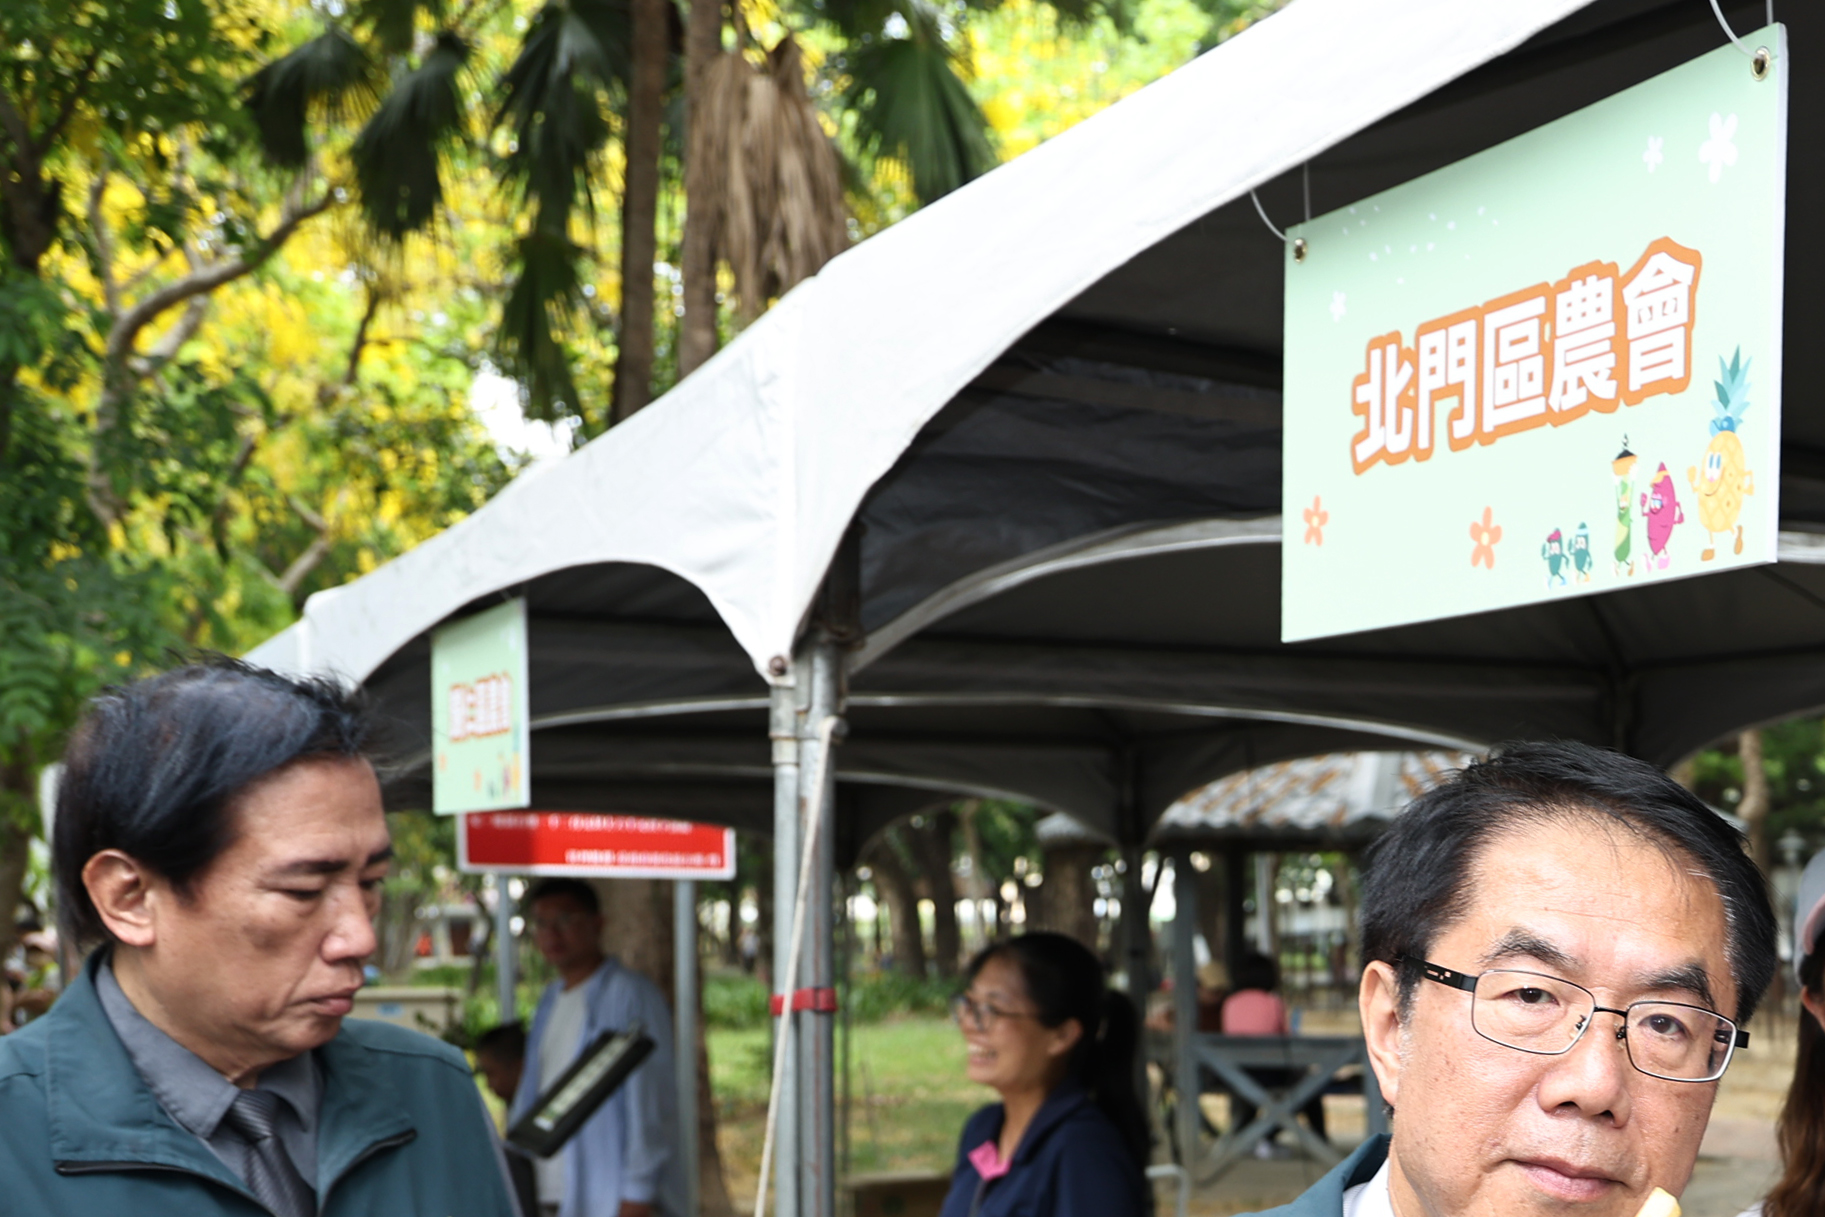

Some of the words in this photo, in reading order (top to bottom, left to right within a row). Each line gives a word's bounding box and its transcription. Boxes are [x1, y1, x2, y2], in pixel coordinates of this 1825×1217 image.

[1354, 244, 1699, 468] 北門區農會
